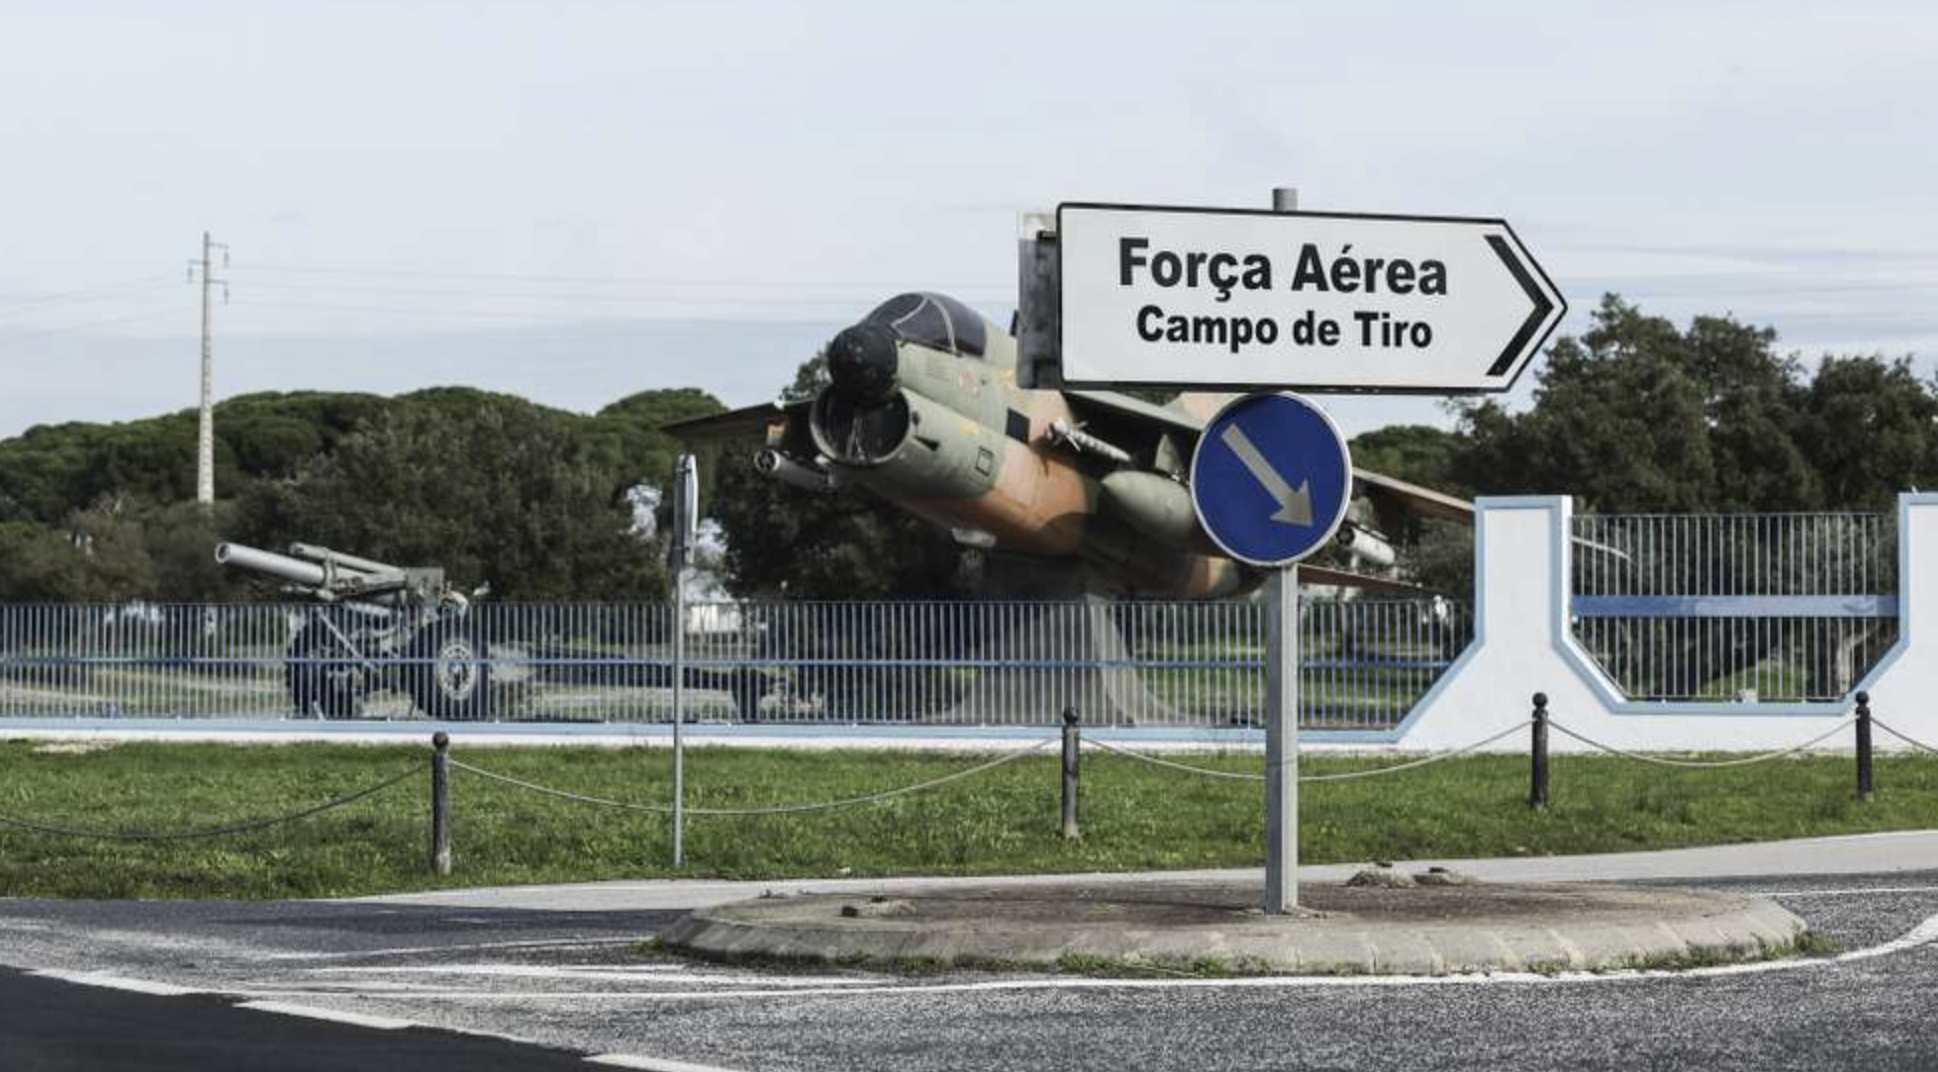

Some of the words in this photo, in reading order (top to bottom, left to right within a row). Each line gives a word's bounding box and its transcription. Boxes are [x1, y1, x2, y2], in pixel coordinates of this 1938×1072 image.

[1118, 237, 1272, 303] Força
[1291, 243, 1447, 296] Aérea
[1136, 304, 1279, 354] Campo
[1292, 309, 1341, 347] de
[1353, 311, 1433, 349] Tiro
